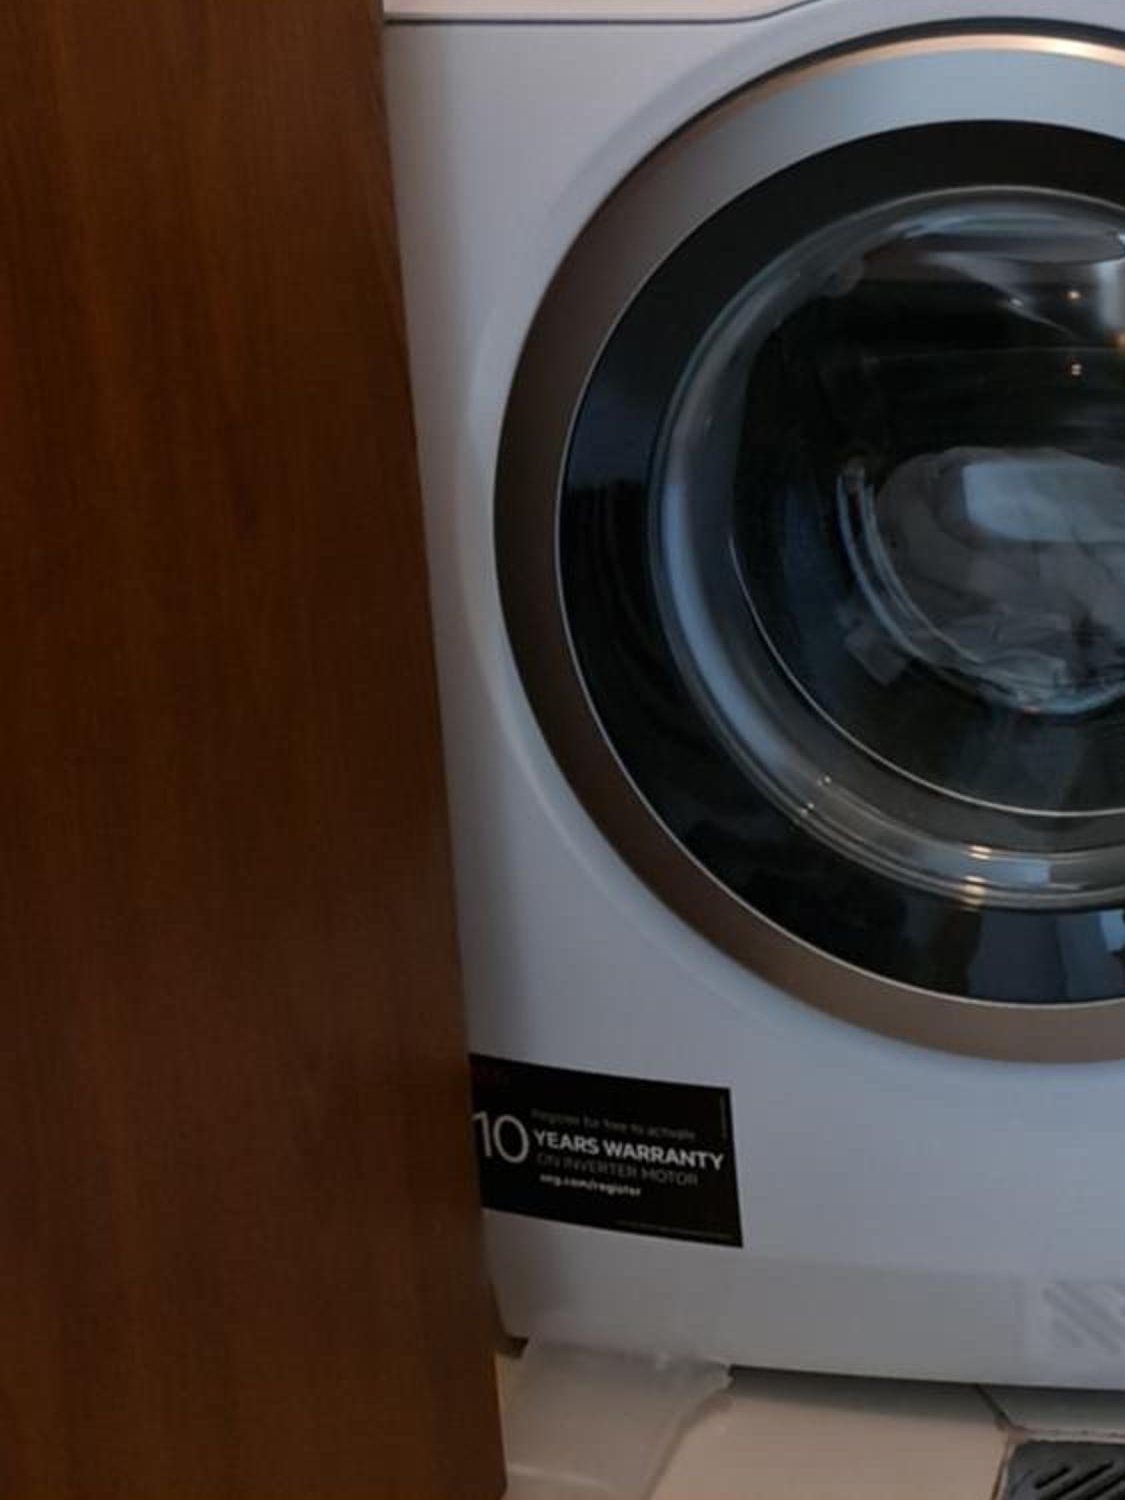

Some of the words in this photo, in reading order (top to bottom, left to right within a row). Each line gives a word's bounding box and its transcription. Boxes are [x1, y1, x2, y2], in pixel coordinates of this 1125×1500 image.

[471, 1110, 530, 1165] 10
[533, 1127, 600, 1157] YEARS
[602, 1138, 726, 1172] WARRANTY
[647, 1125, 696, 1141] activate
[536, 1151, 560, 1169] ON
[563, 1155, 638, 1178] INVERTER
[641, 1166, 699, 1187] MOTOR
